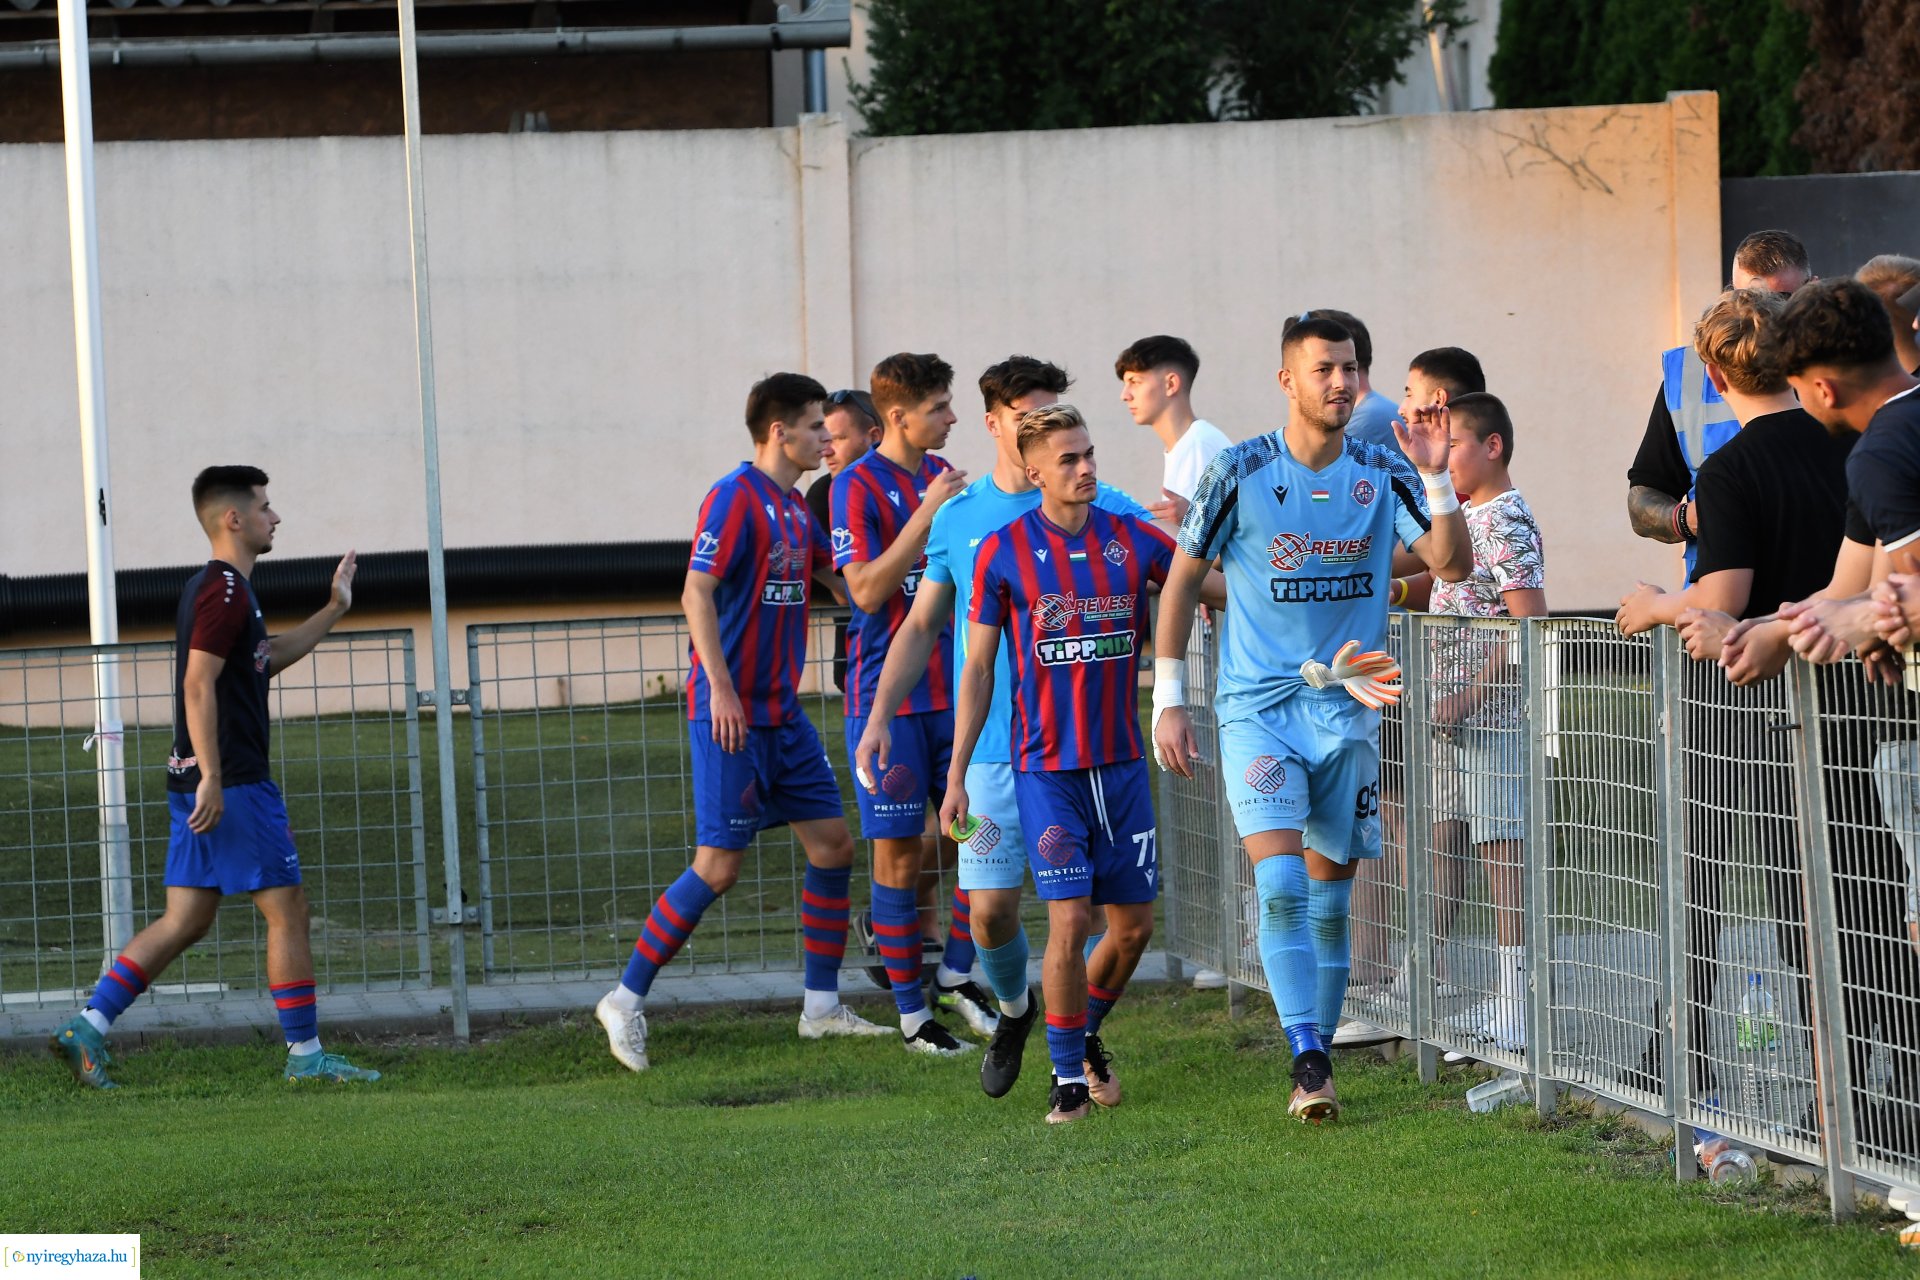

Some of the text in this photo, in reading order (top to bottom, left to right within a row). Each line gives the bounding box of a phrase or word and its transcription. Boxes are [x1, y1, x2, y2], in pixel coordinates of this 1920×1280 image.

[1074, 593, 1137, 614] REVESZ
[1238, 797, 1297, 807] PRESTIGE
[1355, 780, 1377, 819] 95
[1132, 827, 1156, 868] 77
[1038, 866, 1087, 878] PRESTIGE
